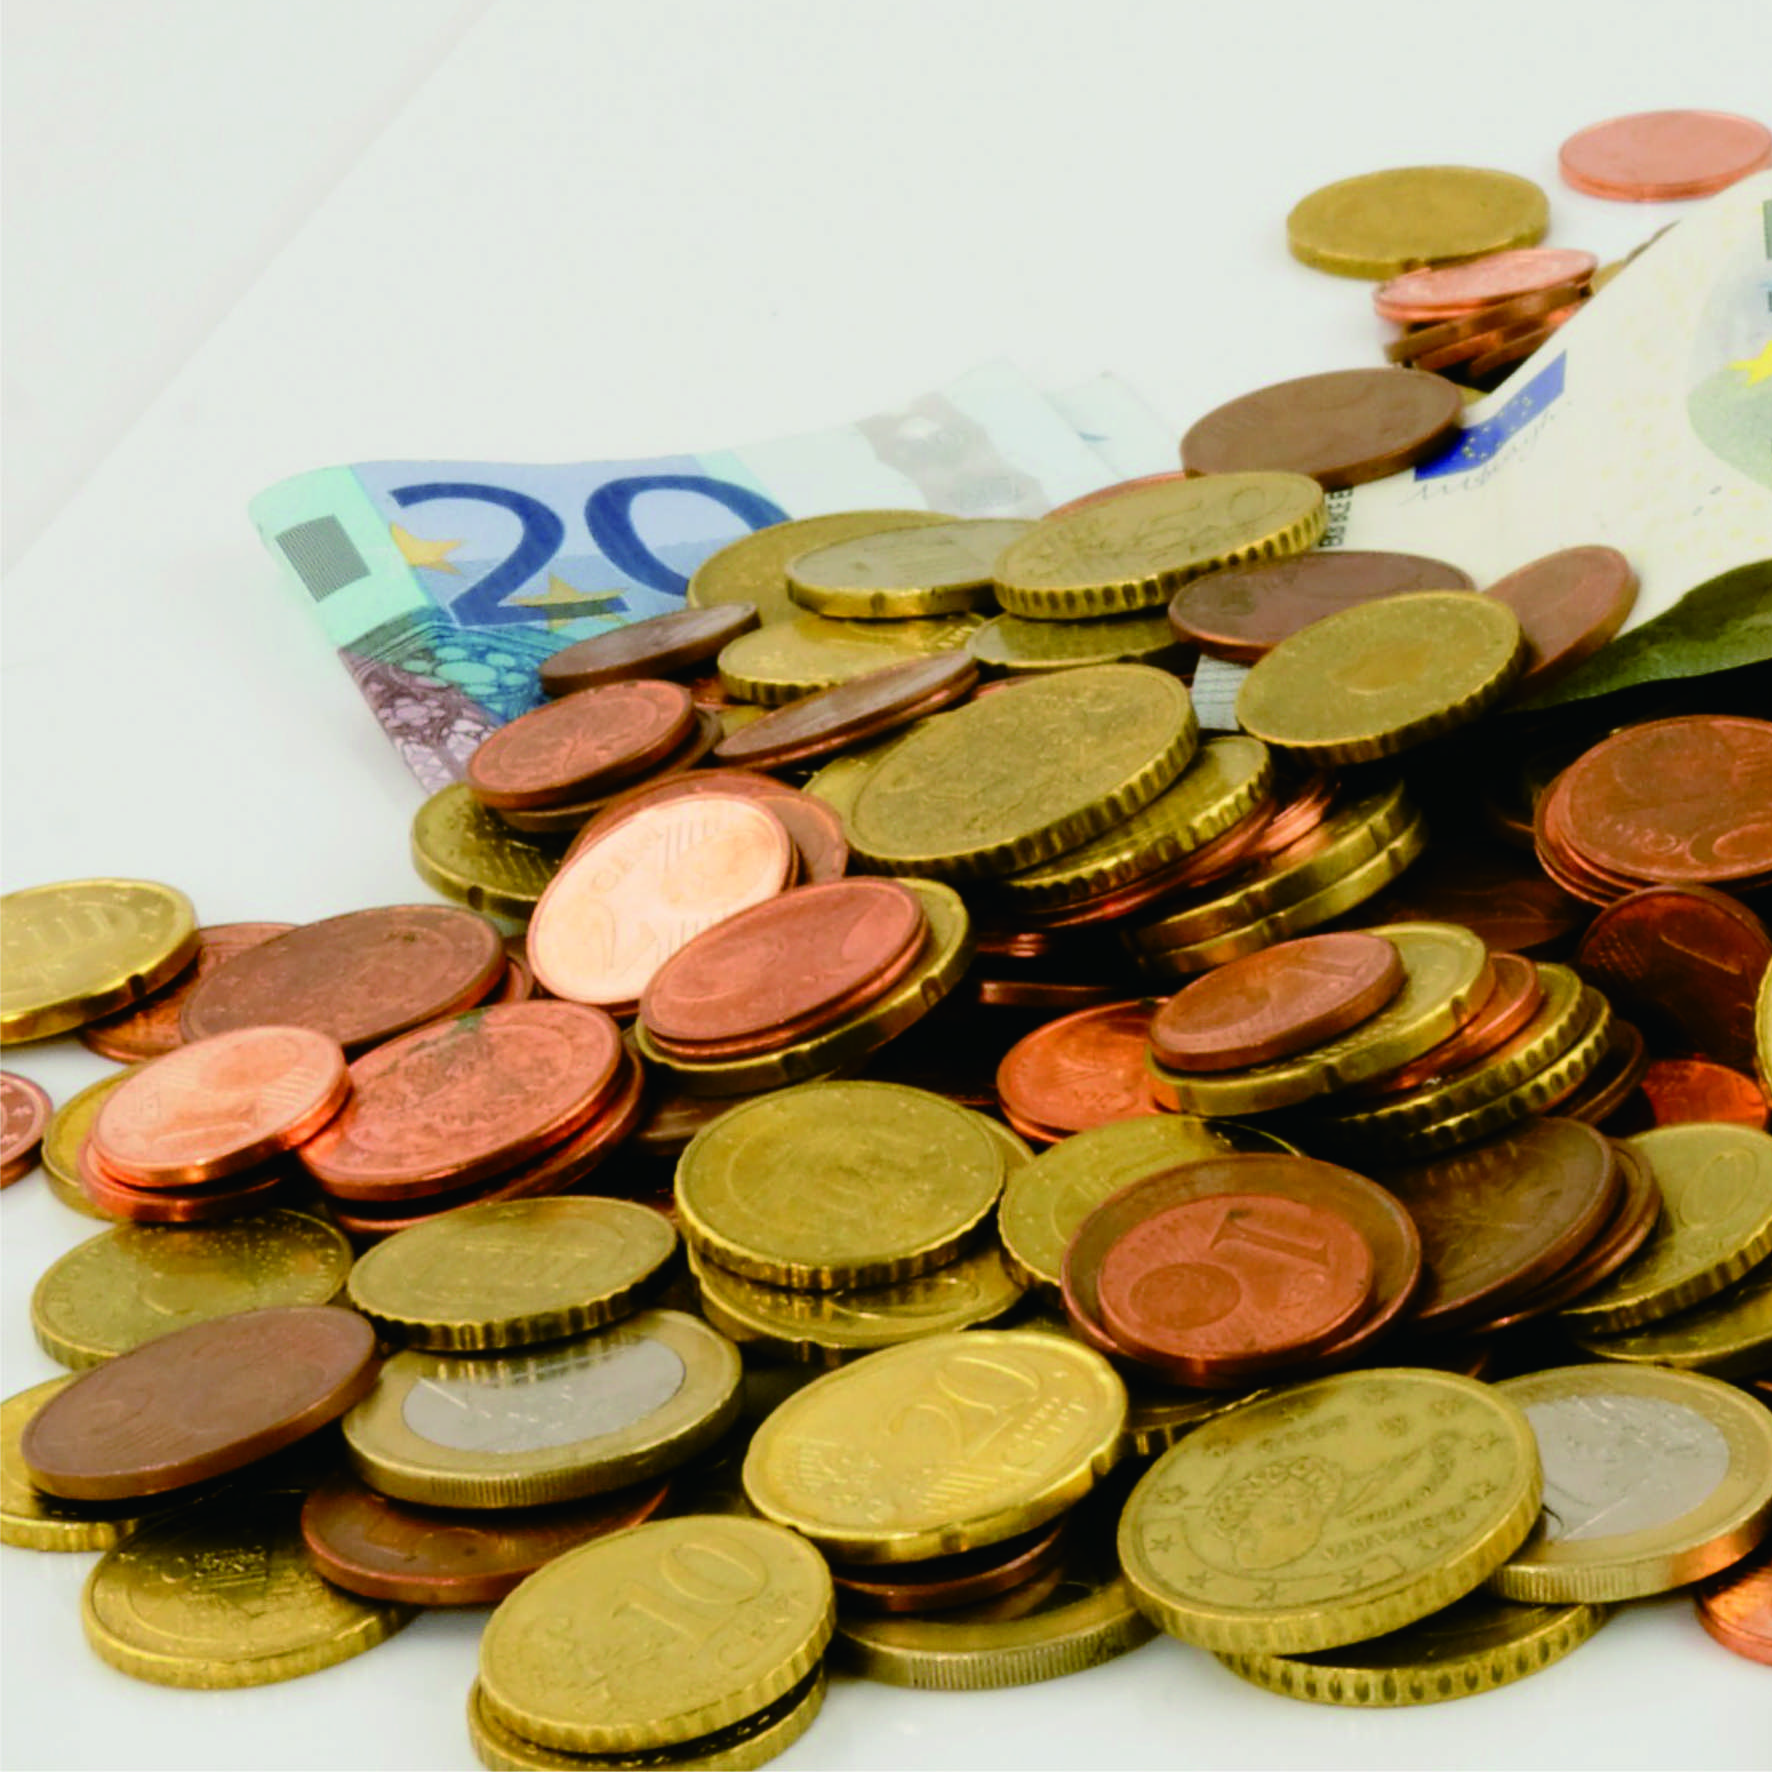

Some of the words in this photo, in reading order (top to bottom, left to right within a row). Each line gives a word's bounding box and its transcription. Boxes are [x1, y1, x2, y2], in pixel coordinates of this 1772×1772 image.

[388, 474, 795, 628] 20
[884, 1353, 1043, 1470] 20
[608, 1534, 772, 1640] 10
